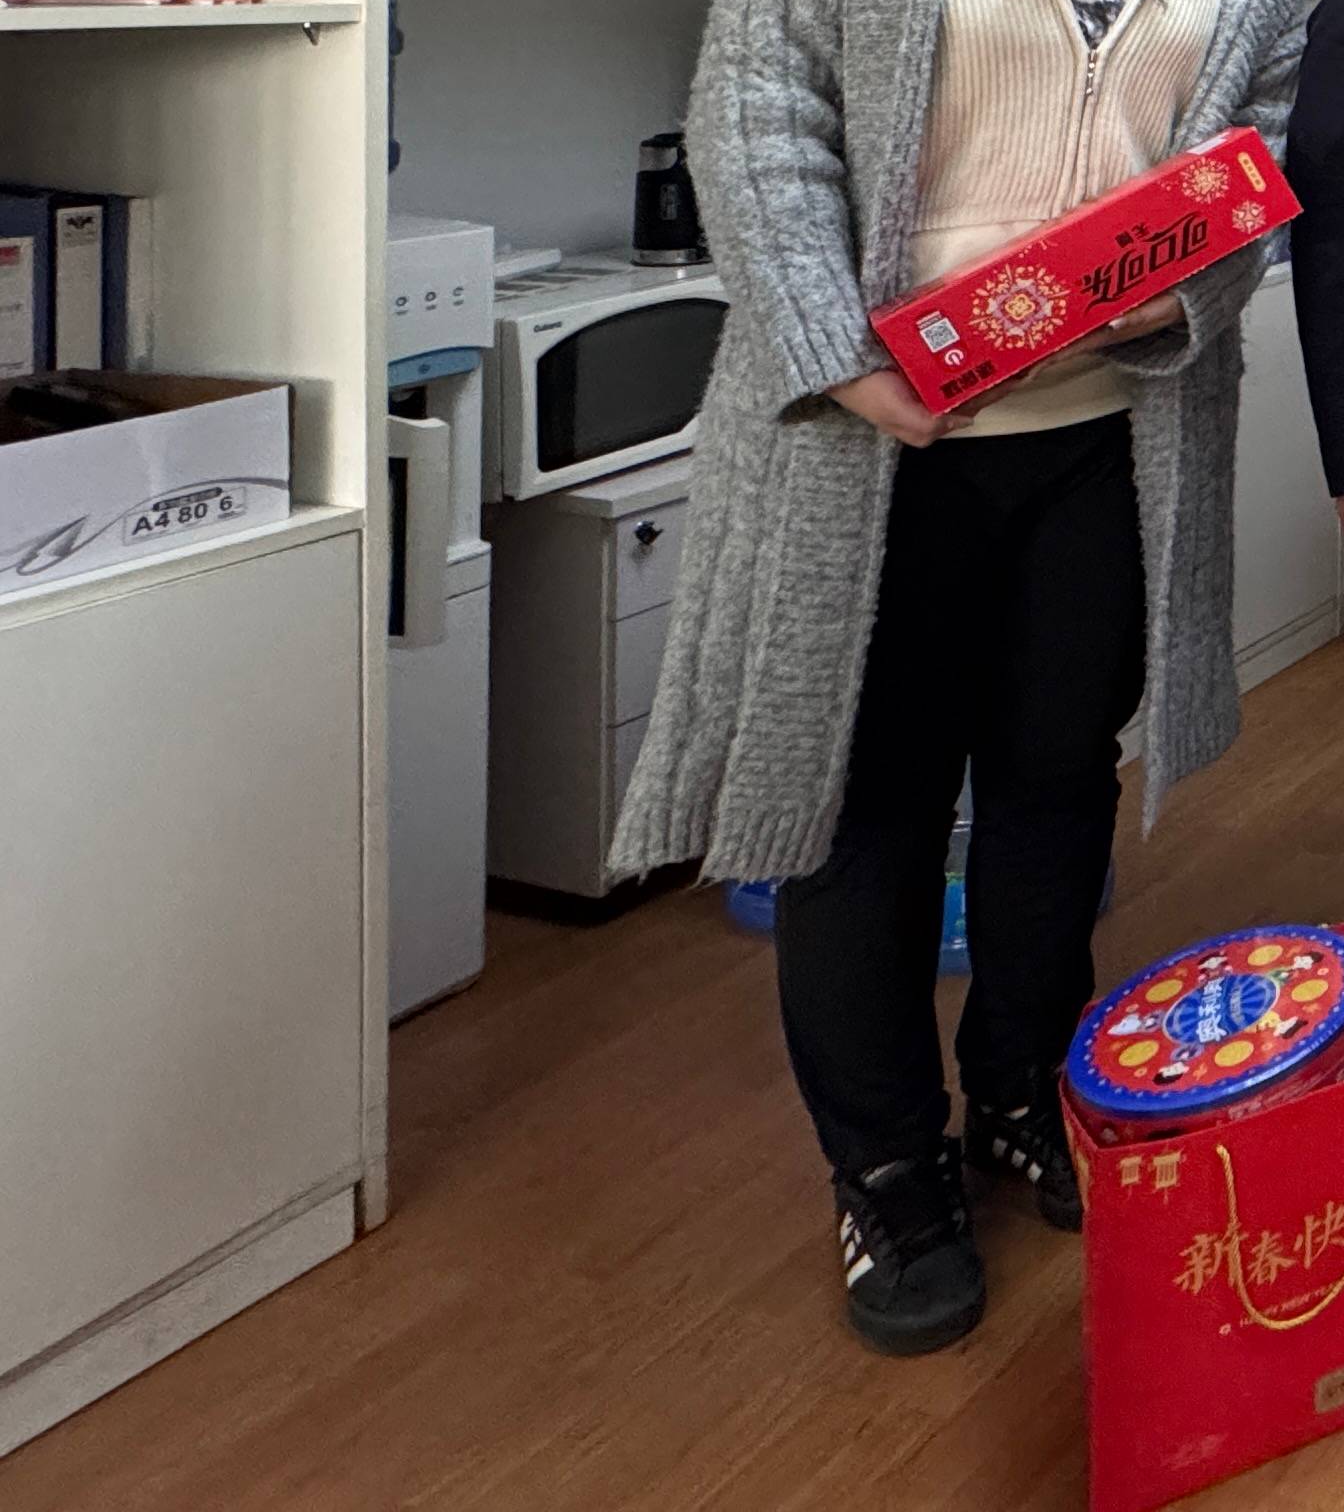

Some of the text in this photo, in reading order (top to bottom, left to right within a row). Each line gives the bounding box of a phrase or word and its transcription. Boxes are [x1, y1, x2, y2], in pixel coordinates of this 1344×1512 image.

[131, 511, 171, 536] A4
[177, 502, 209, 524] 80
[219, 496, 233, 512] 6
